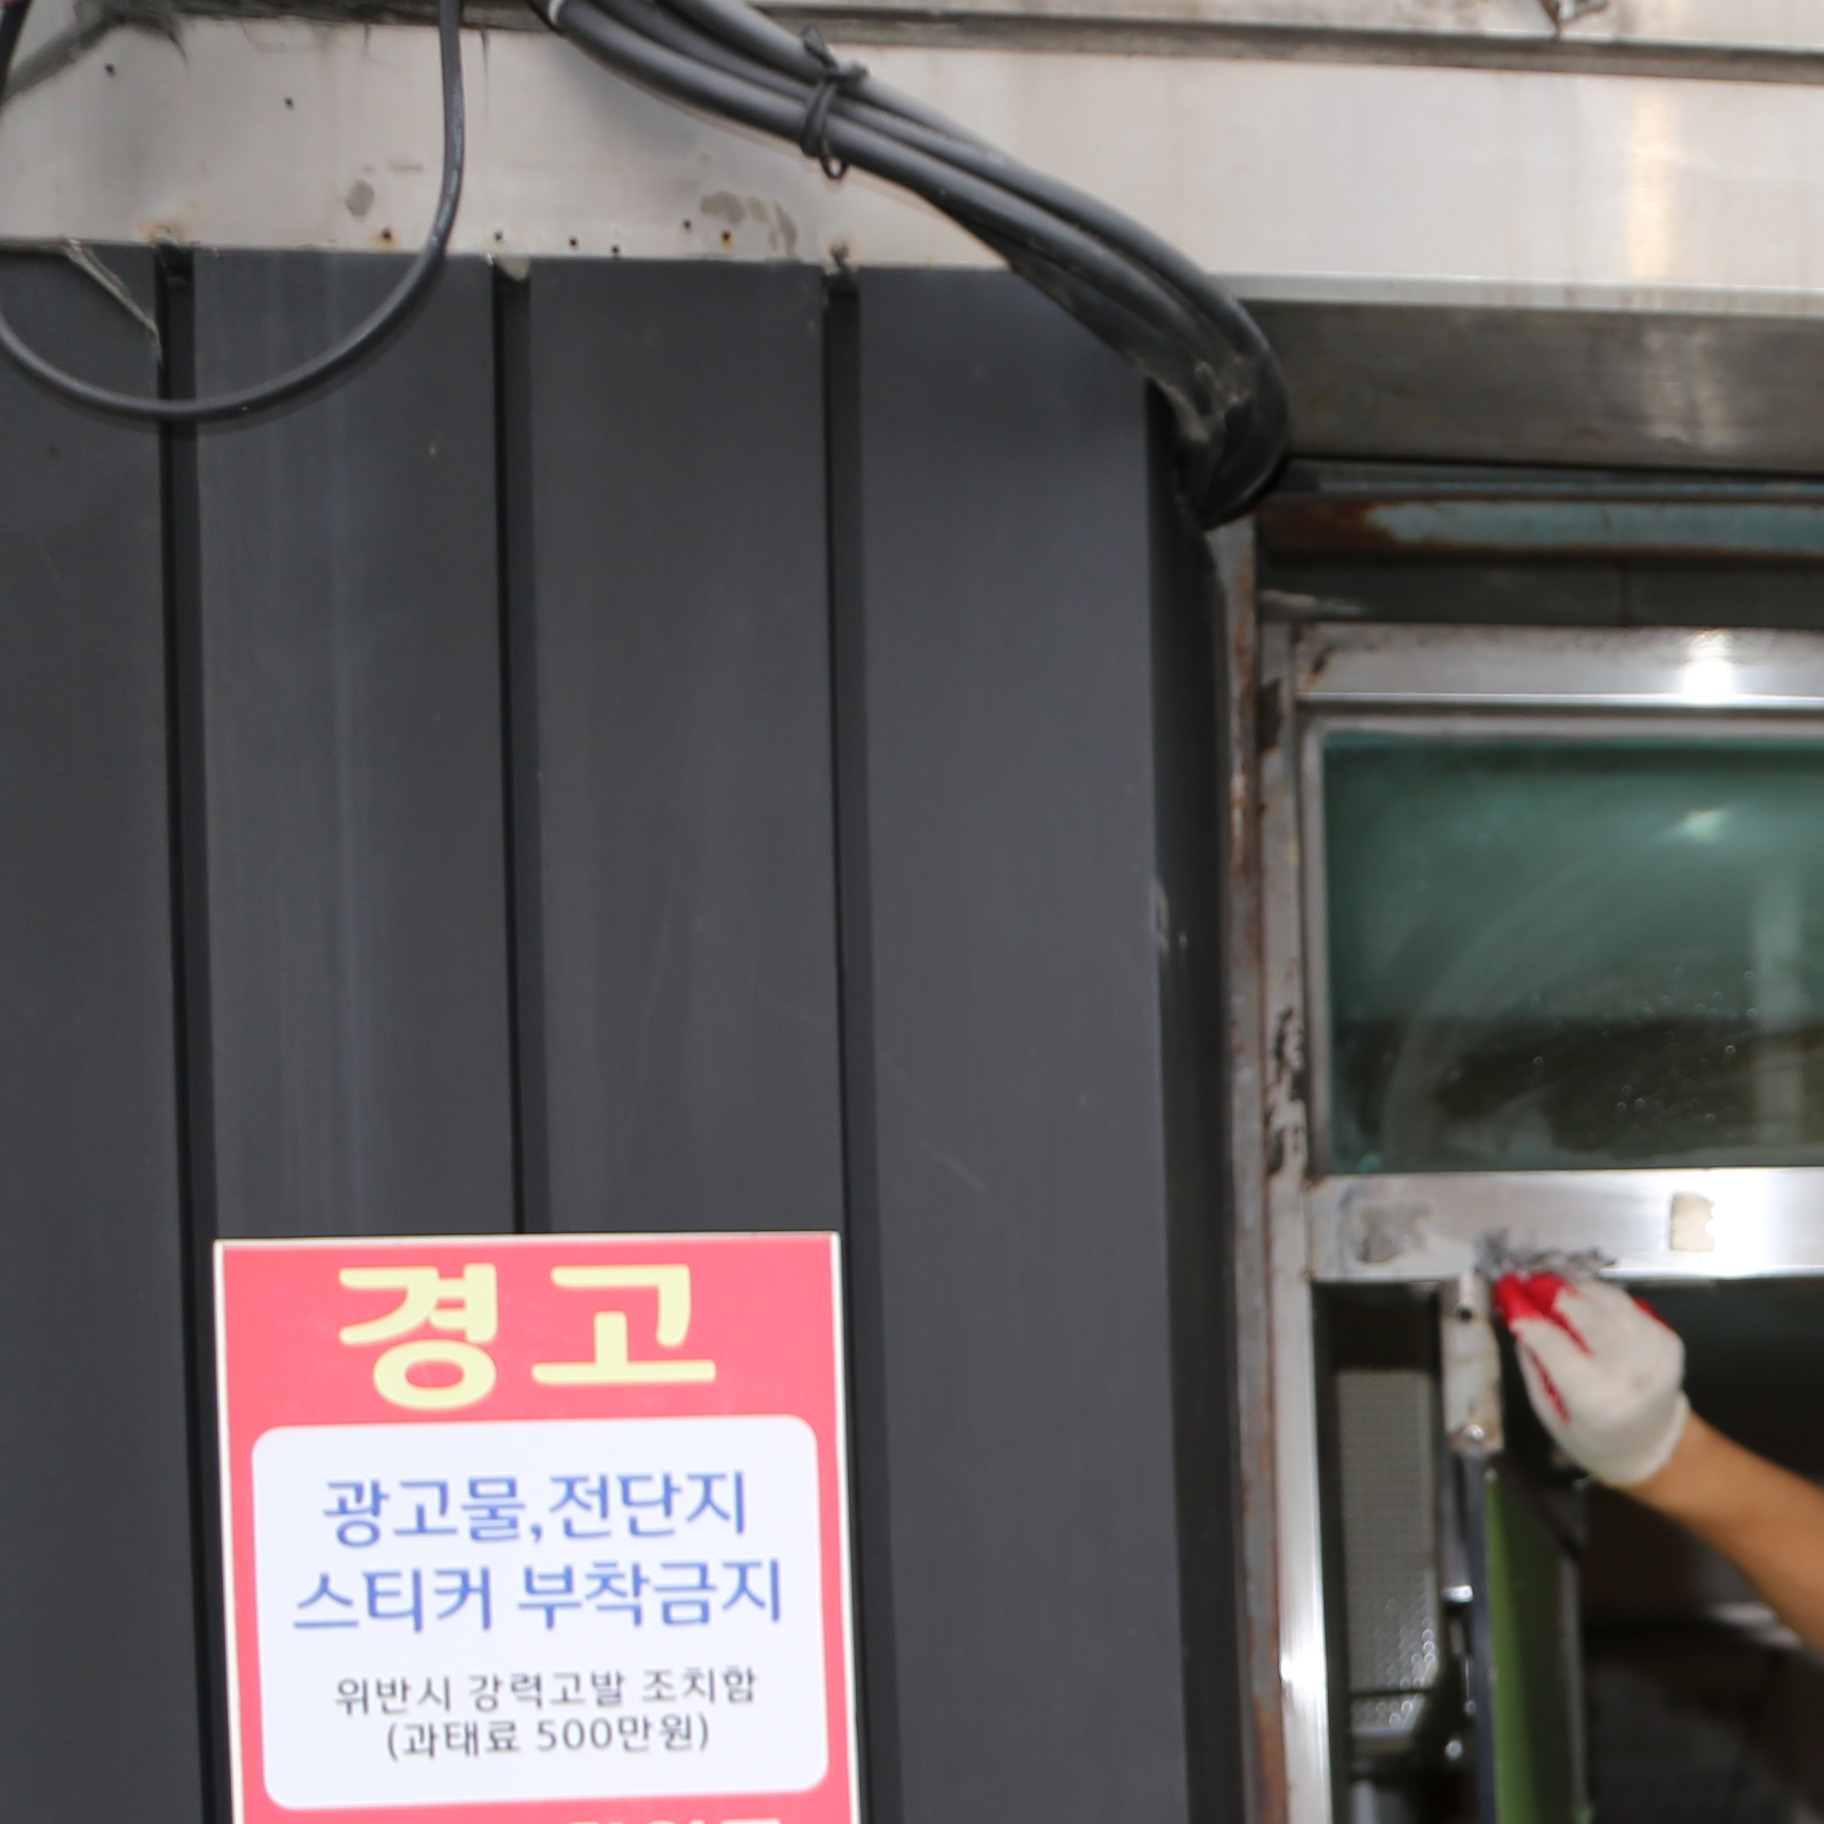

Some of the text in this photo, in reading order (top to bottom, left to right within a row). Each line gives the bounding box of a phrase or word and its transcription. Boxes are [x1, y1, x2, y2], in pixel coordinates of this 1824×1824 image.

[339, 1262, 717, 1410] 경고
[322, 1470, 747, 1548] 광고물,전단지
[292, 1557, 783, 1634] 스티커 부착금지
[334, 1664, 758, 1717] 위반시 강력고발 조치함
[386, 1711, 711, 1761] (과태료 500만원)
